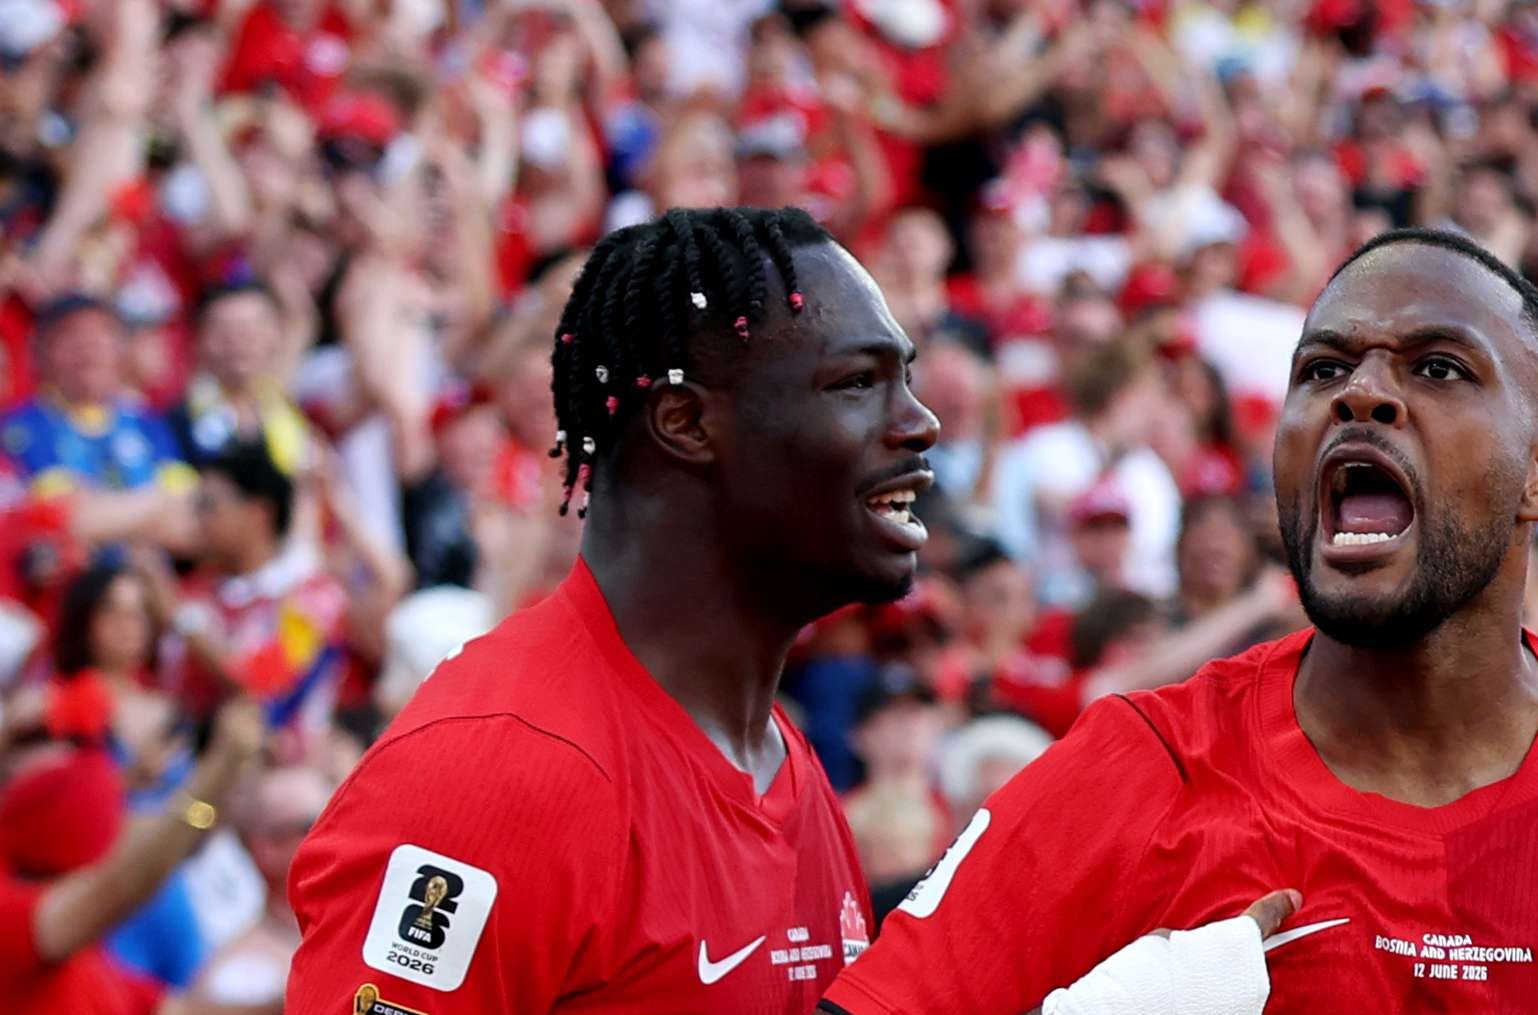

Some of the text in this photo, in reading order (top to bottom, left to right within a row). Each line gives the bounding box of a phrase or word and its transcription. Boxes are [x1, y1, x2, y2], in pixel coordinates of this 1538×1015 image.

[408, 926, 432, 943] FIFA
[1423, 934, 1473, 947] CANADA
[391, 942, 438, 962] WORLD CUP
[1375, 935, 1533, 963] BOSNIA AND HERZEGOVINA
[386, 950, 436, 976] 2026
[1414, 963, 1488, 981] 12 JUNE 2026
